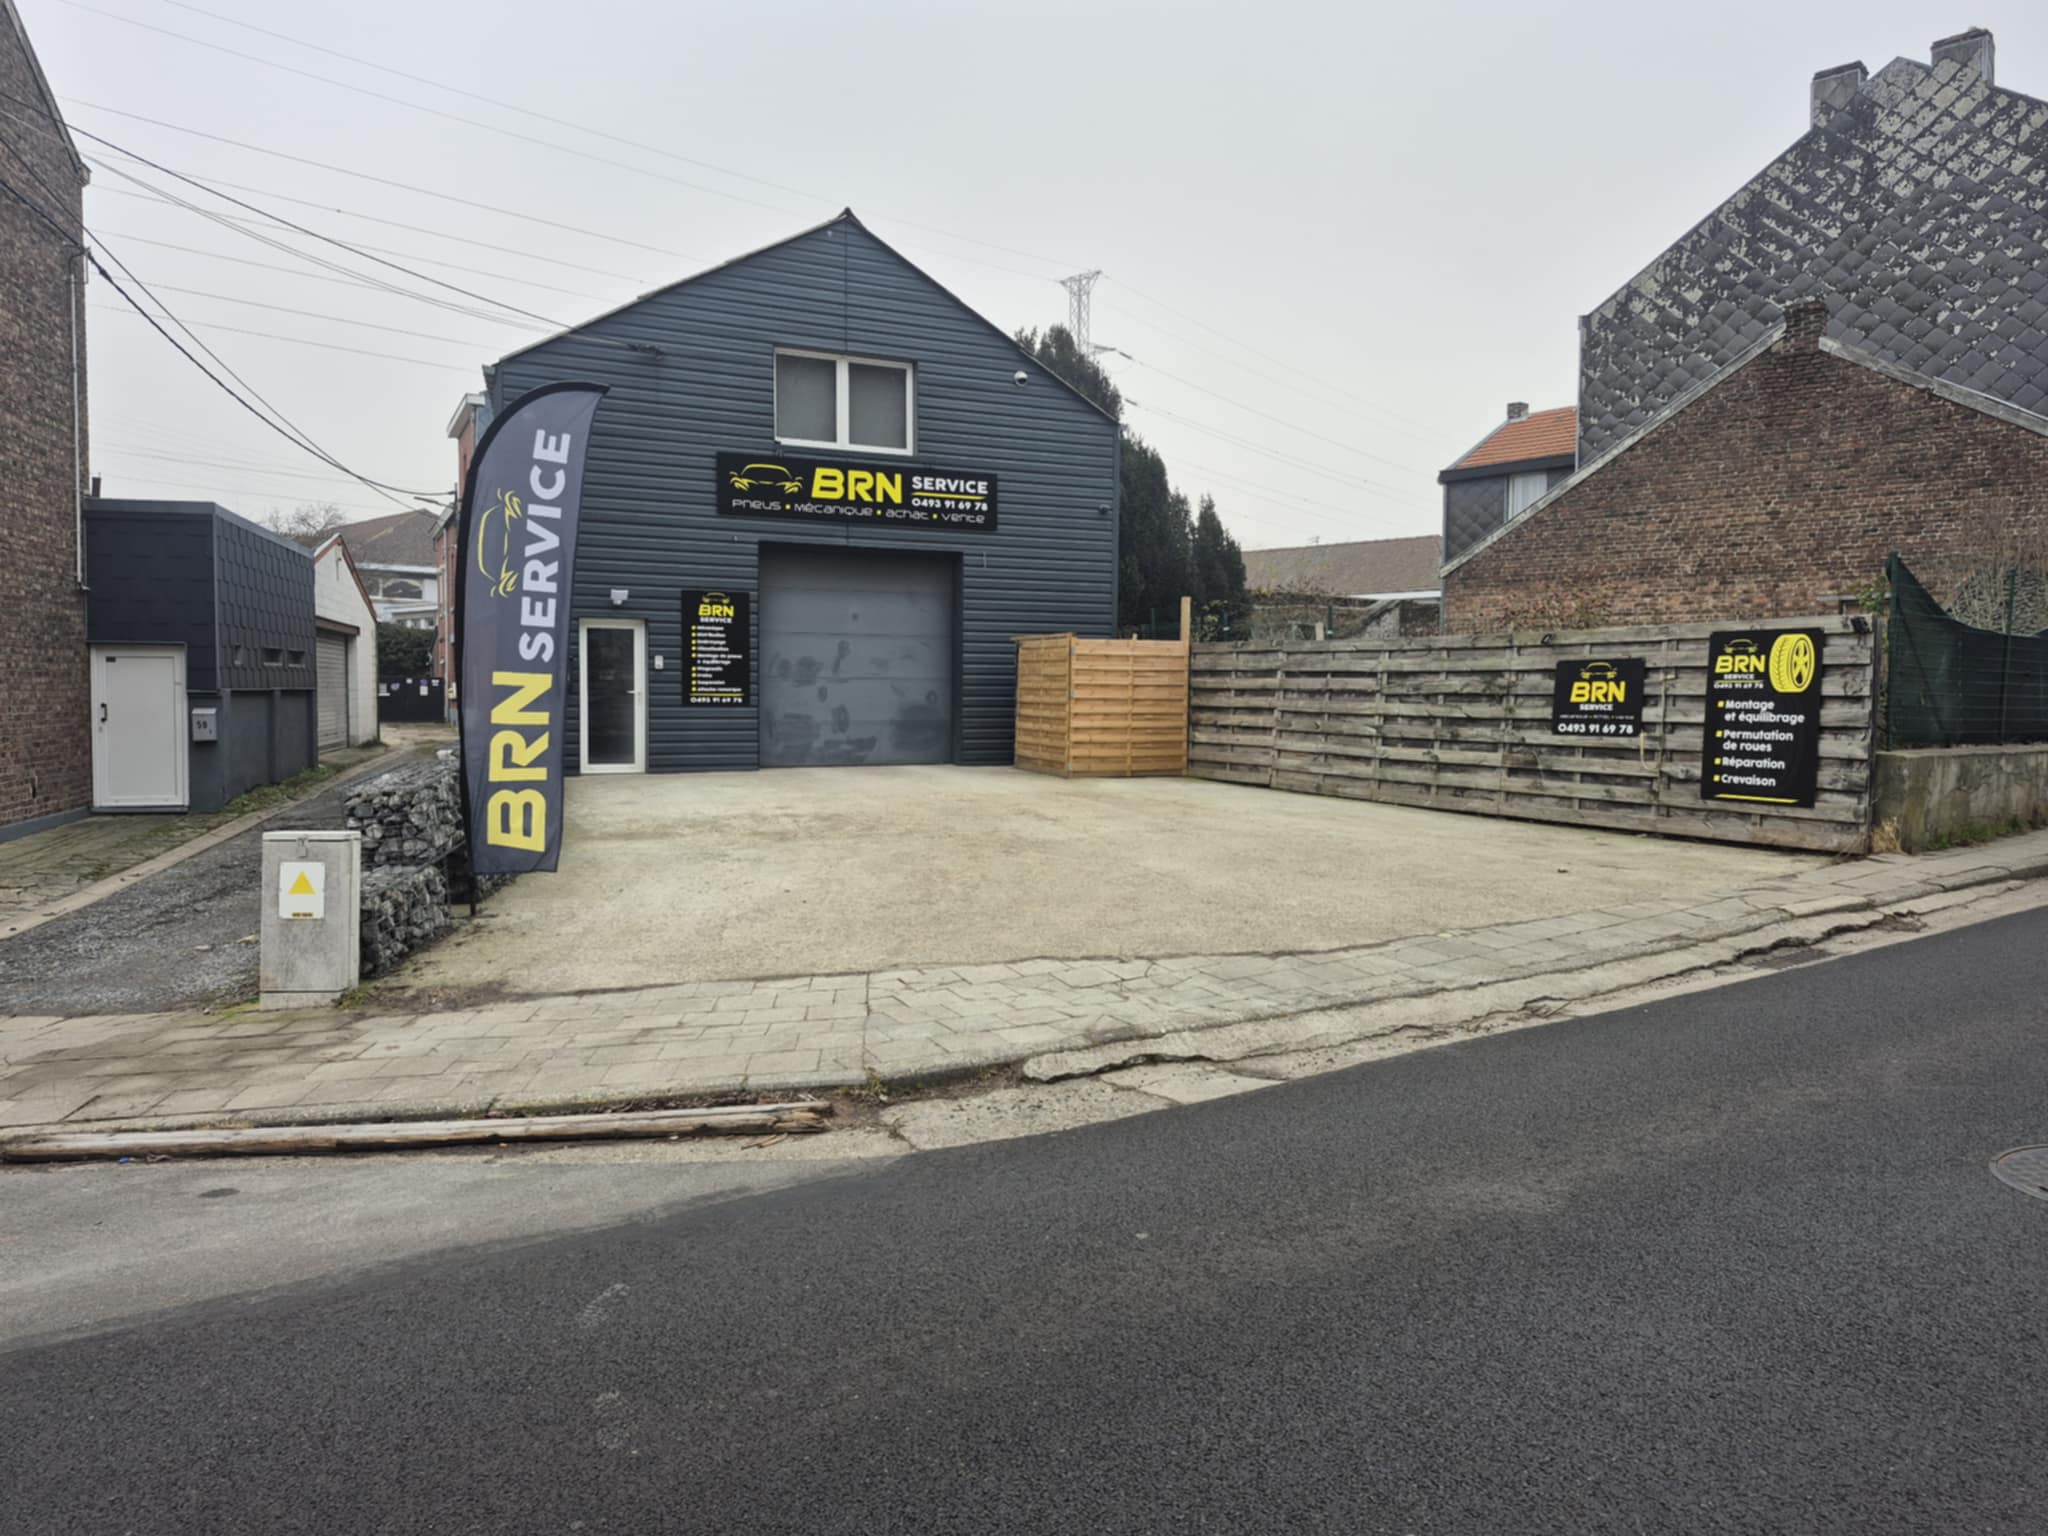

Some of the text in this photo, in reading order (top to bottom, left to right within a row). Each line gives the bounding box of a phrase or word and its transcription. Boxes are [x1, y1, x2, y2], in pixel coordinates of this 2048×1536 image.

[811, 467, 902, 504] BRN
[912, 476, 988, 494] SERVICE
[731, 498, 782, 511] Pneus
[911, 497, 988, 511] 0493 91 69 78
[698, 604, 734, 617] BRN
[486, 429, 572, 852] BRN SERVICE
[1714, 654, 1766, 673] BRN
[1569, 680, 1626, 703] BRN
[1725, 699, 1775, 713] Montage
[1724, 710, 1805, 725] et équilibrage
[1558, 723, 1633, 734] 0493 91 69 78
[1723, 729, 1794, 742] Permutation
[1723, 740, 1772, 752] de roues
[1721, 756, 1785, 770] Réparation
[1721, 773, 1776, 787] Crevaison
